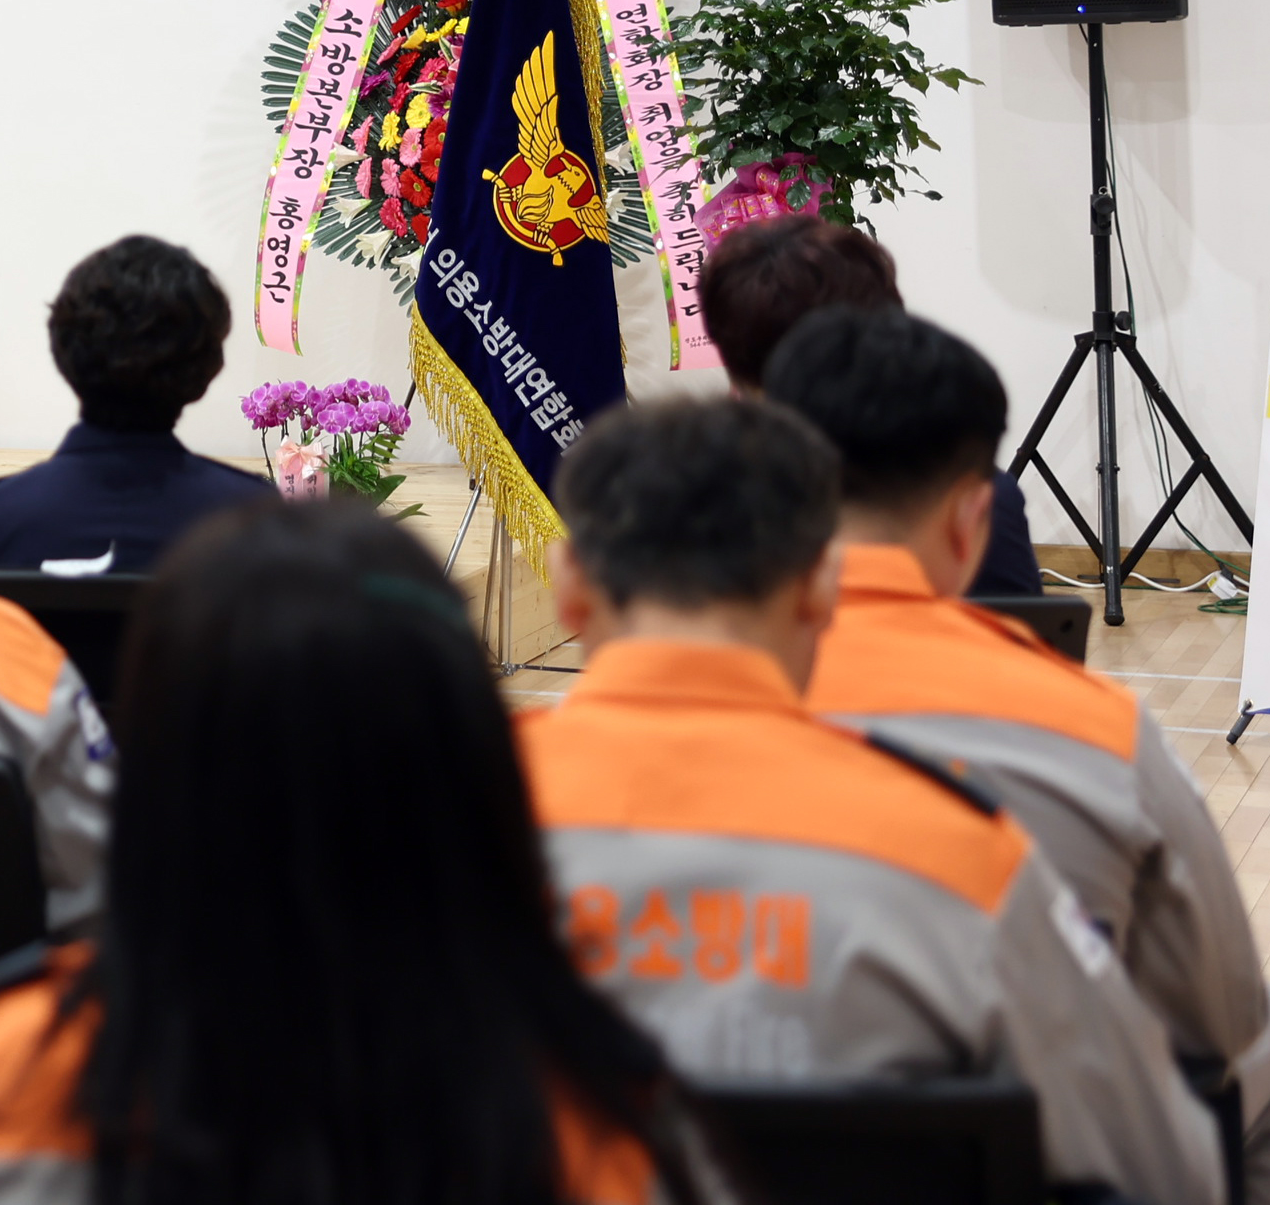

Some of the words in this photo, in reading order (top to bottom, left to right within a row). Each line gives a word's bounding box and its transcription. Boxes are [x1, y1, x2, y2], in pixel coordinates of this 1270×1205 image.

[287, 8, 363, 179] 소방본부장
[262, 196, 303, 304] 홍영근
[558, 883, 812, 989] 용소방대
